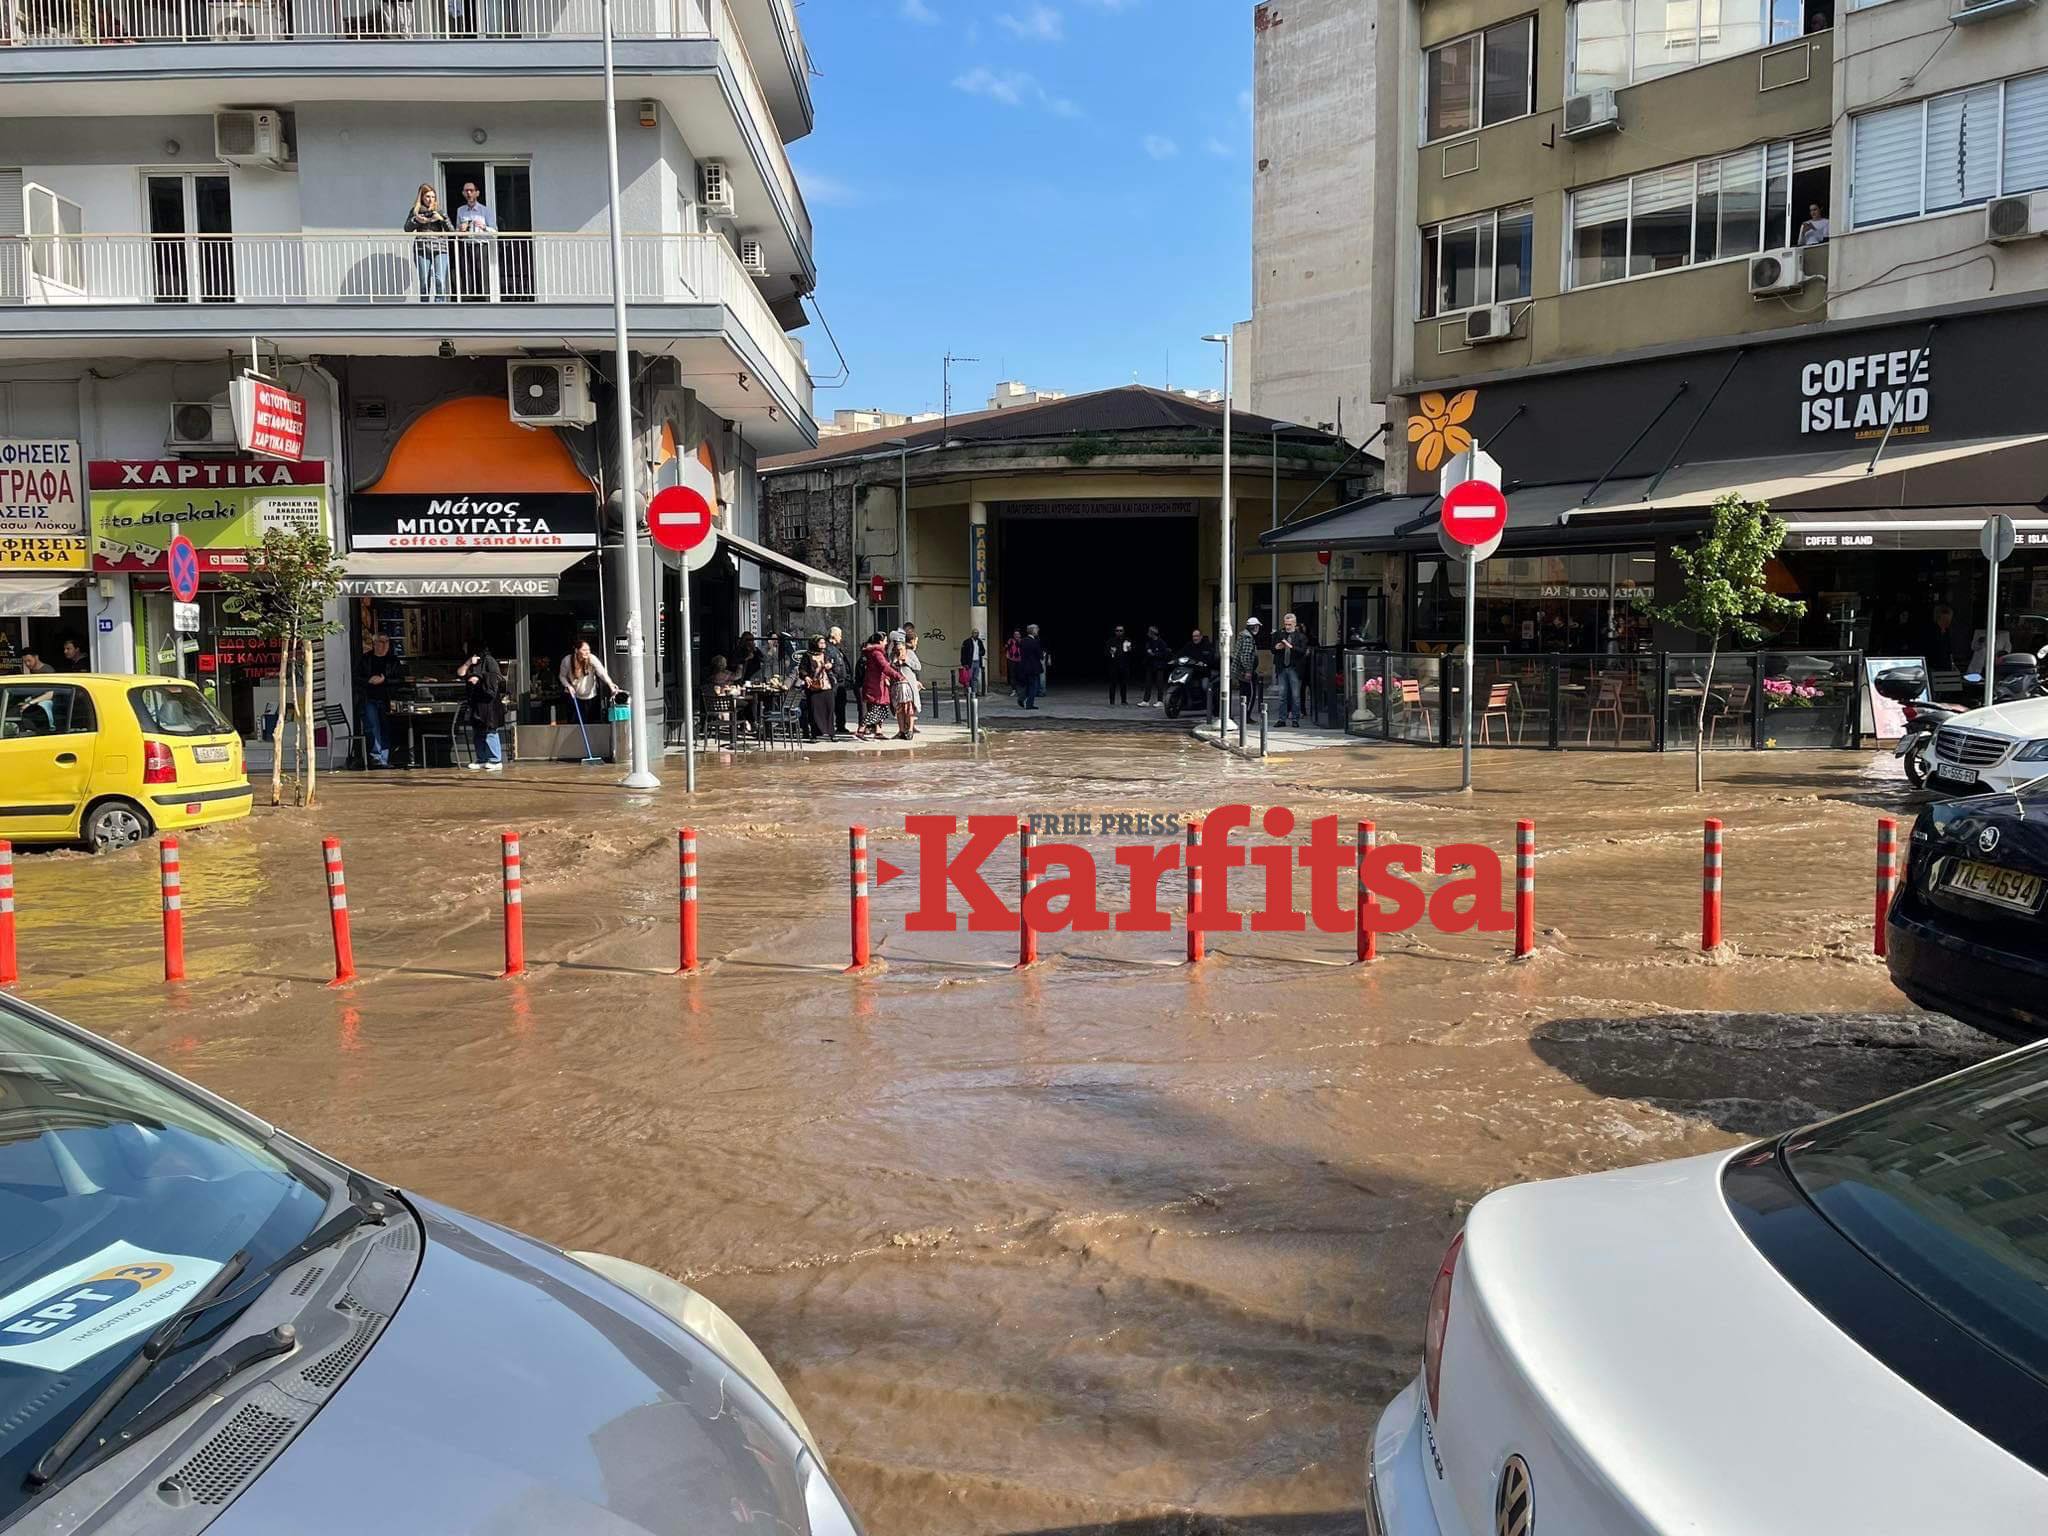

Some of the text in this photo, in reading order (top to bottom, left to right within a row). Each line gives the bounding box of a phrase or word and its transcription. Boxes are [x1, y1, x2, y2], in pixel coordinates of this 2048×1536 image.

[1801, 347, 1930, 396] COFFEE
[1801, 387, 1929, 433] ISLAND
[257, 410, 302, 435] ΜΕΤΑΦΡΑΣΕΙΣ
[256, 431, 284, 451] ΧΑΡΤΙΚΑ
[0, 444, 70, 464] ΦΗΣΕΙΣ
[122, 465, 293, 484] ΧΑΡΤΙΚΑ
[427, 497, 520, 516] Μάνος
[34, 520, 76, 530] Λιόκου
[397, 518, 550, 534] ΜΠΟΥΓΑΤΣΑ
[389, 534, 562, 546] coffee & sandwich
[1805, 536, 1873, 545] COFFEE ISLAND
[976, 527, 987, 604] PARKING
[420, 579, 491, 594] ΜΑΝΟΣ
[499, 579, 550, 594] ΚΑΦΕ
[219, 639, 245, 648] ΕΔΩ
[217, 653, 235, 663] ΤΙΣ
[3, 1266, 162, 1335] ΕΡΤ 3
[71, 1279, 197, 1343] ΤΗΛΕΟΠΤΙΚΟ ΣΥΝΕΡΓΕΙΟ
